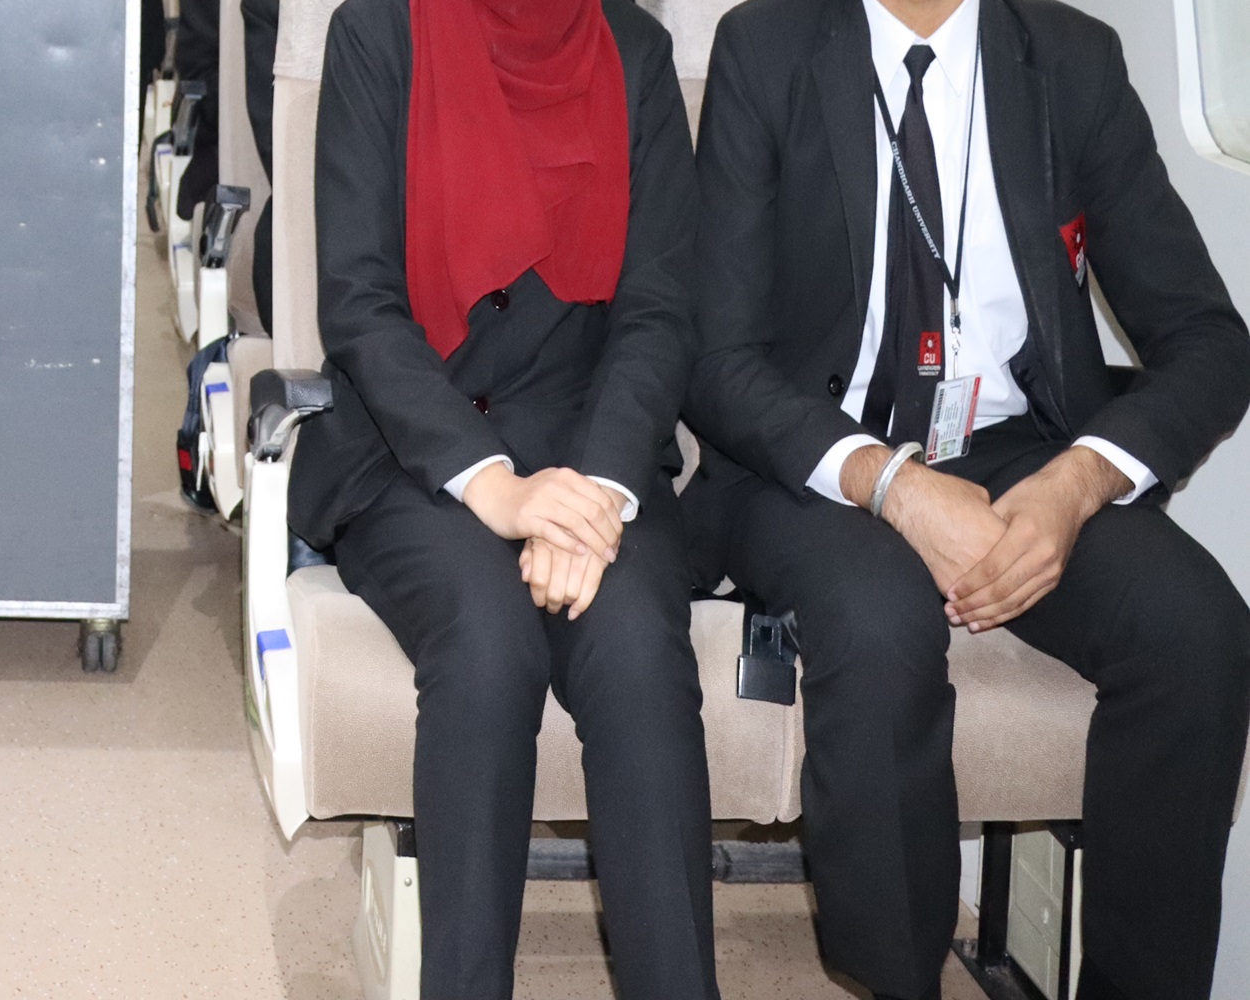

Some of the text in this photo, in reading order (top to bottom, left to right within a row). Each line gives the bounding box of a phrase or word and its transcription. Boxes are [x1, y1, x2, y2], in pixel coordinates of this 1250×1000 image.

[891, 141, 941, 259] CHANDIGARH UNIVERSITY
[923, 352, 936, 364] CU
